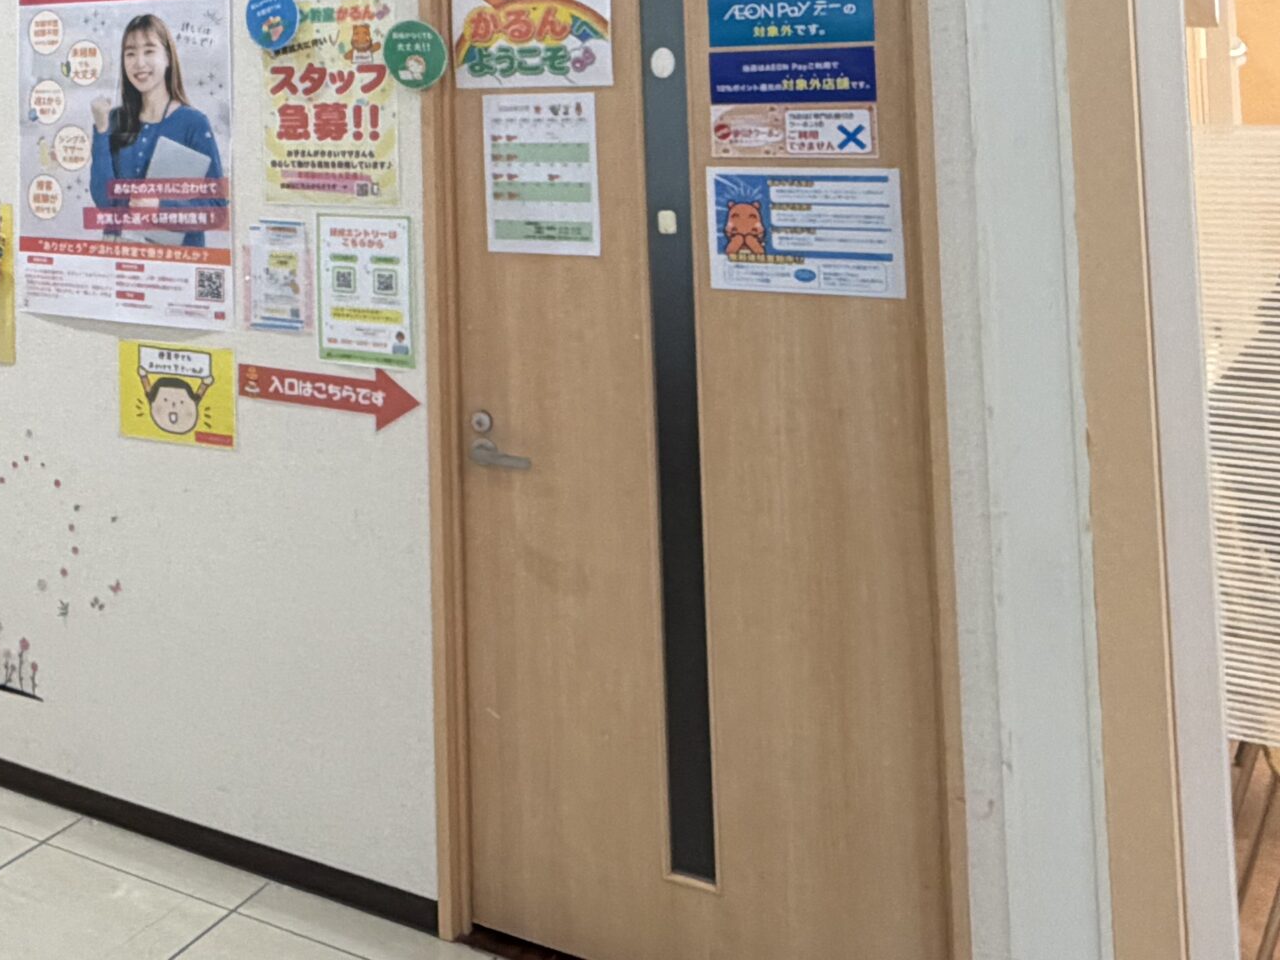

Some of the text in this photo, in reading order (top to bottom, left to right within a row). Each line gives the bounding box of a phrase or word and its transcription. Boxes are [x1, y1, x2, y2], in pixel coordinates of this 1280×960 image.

[753, 24, 826, 38] 対象外です。
[469, 45, 571, 78] ようこそ
[270, 62, 387, 96] スタッフ
[789, 141, 836, 151] できません
[113, 182, 217, 195] あなたのスキルに合わせて
[269, 375, 386, 407] 入口はこちらです
